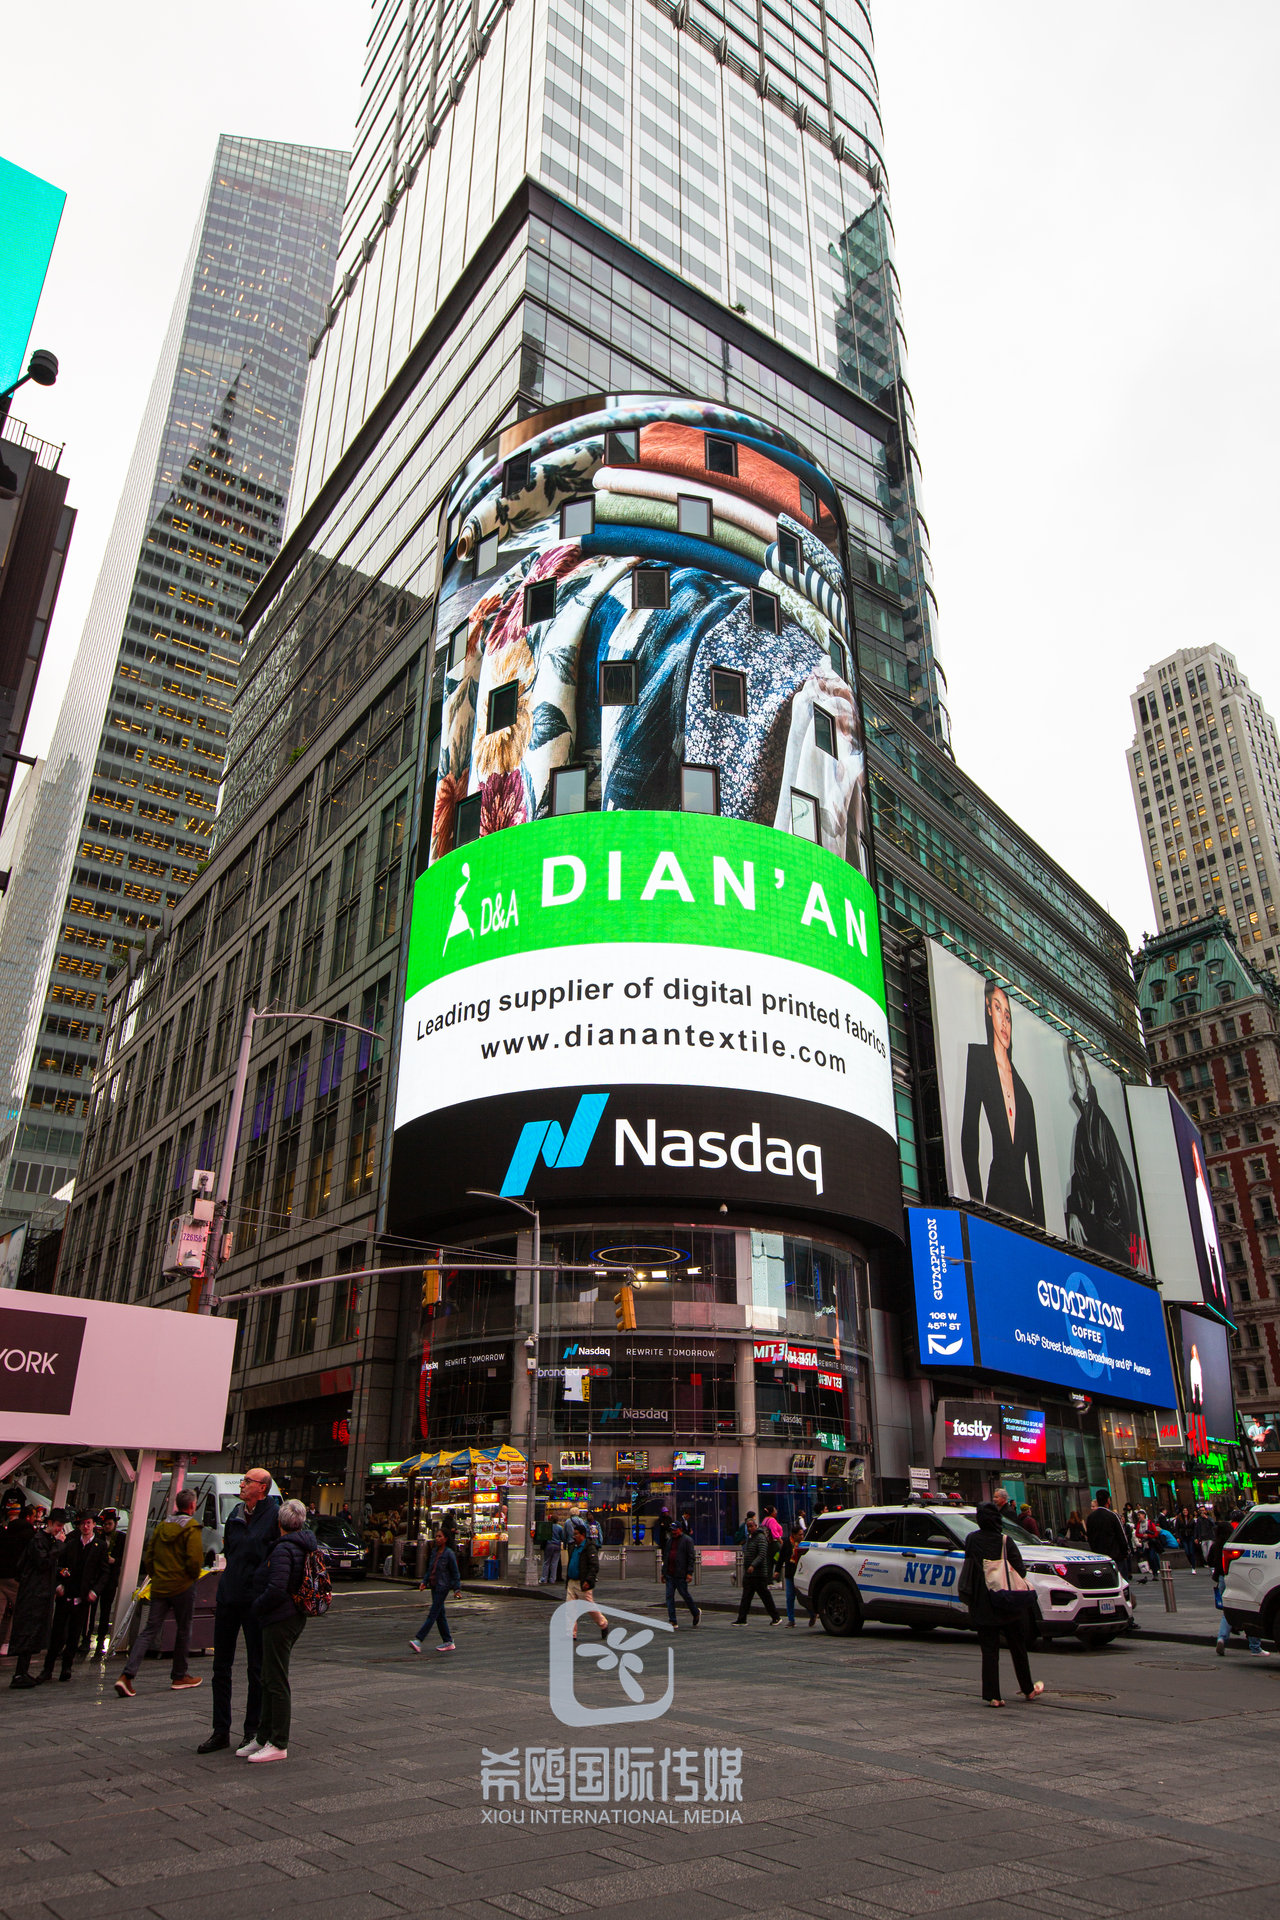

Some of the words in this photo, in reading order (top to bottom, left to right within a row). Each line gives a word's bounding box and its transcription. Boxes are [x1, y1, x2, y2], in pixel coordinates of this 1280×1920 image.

[480, 889, 519, 937] D&A
[416, 996, 491, 1042] Leading
[498, 979, 614, 1013] supplier
[624, 976, 655, 999] of
[663, 977, 752, 1008] digital
[761, 990, 840, 1030] printed
[845, 1013, 887, 1059] fabrics
[481, 1023, 847, 1075] www.dianantextile.com
[614, 1118, 825, 1196] Nasdaq
[927, 1217, 943, 1300] GUMPTION
[929, 1312, 946, 1320] 106
[948, 1312, 957, 1320] W
[1037, 1279, 1125, 1332] GUMPTION
[578, 1346, 611, 1357] Nasdaq
[626, 1348, 664, 1356] REWRITE
[668, 1349, 716, 1358] TOMORROW
[1071, 1324, 1102, 1344] COFFEE
[445, 1357, 466, 1367] REWRITE
[468, 1353, 505, 1364] TOMORROW
[1015, 1329, 1026, 1343] On
[1026, 1332, 1041, 1346] 45th
[1041, 1337, 1062, 1353] Street
[1062, 1342, 1088, 1359] between
[1088, 1349, 1115, 1370] Broadway
[1115, 1358, 1125, 1370] and
[1133, 1362, 1151, 1376] Avenue
[623, 1407, 668, 1422] Nasdaq
[781, 1414, 802, 1425] Nasdaq
[904, 1561, 956, 1587] NYPD
